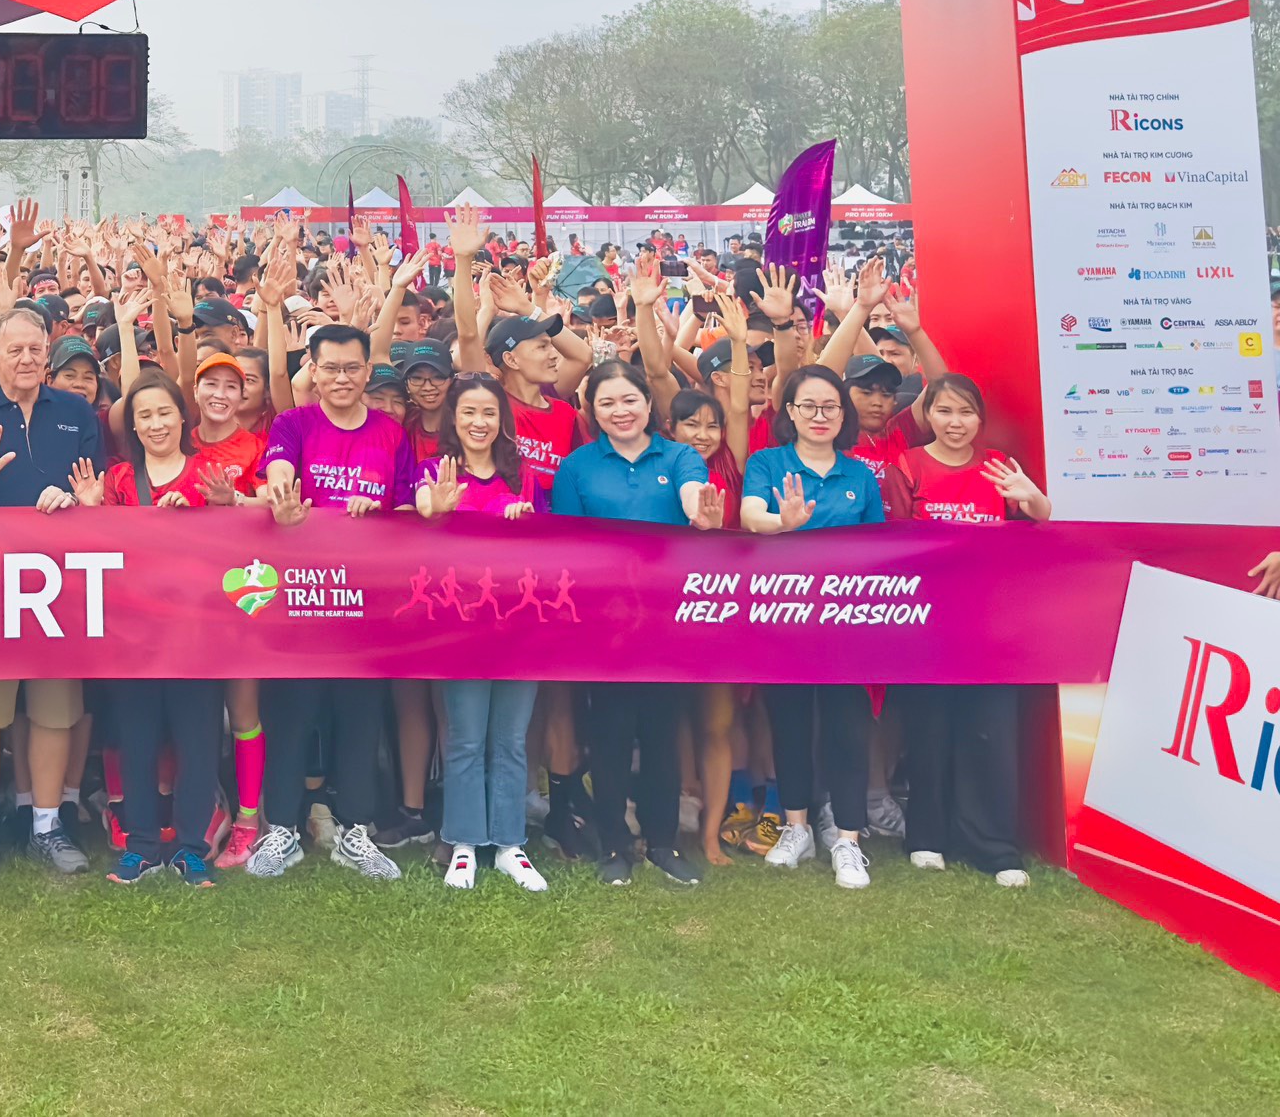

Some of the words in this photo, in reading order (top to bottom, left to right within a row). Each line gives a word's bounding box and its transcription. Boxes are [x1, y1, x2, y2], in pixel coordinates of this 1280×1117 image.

[1140, 94, 1155, 102] TRỢ
[1133, 152, 1149, 160] TRỢ
[1104, 172, 1151, 183] FECON
[1178, 171, 1248, 185] VinaCapital
[1087, 267, 1116, 276] YAMAHA
[1197, 267, 1234, 278] LIXIL
[314, 474, 353, 490] TRÁI
[357, 480, 385, 496] TIM
[285, 569, 327, 585] CHẠY
[330, 565, 346, 584] VÌ
[683, 572, 741, 595] RUN
[749, 574, 815, 596] WITH
[819, 575, 921, 596] RHYTHM
[285, 586, 325, 606] TRÁI
[330, 589, 363, 606] TIM
[675, 600, 740, 623] HELP
[749, 601, 815, 624] WITH
[819, 603, 931, 625] PASSION
